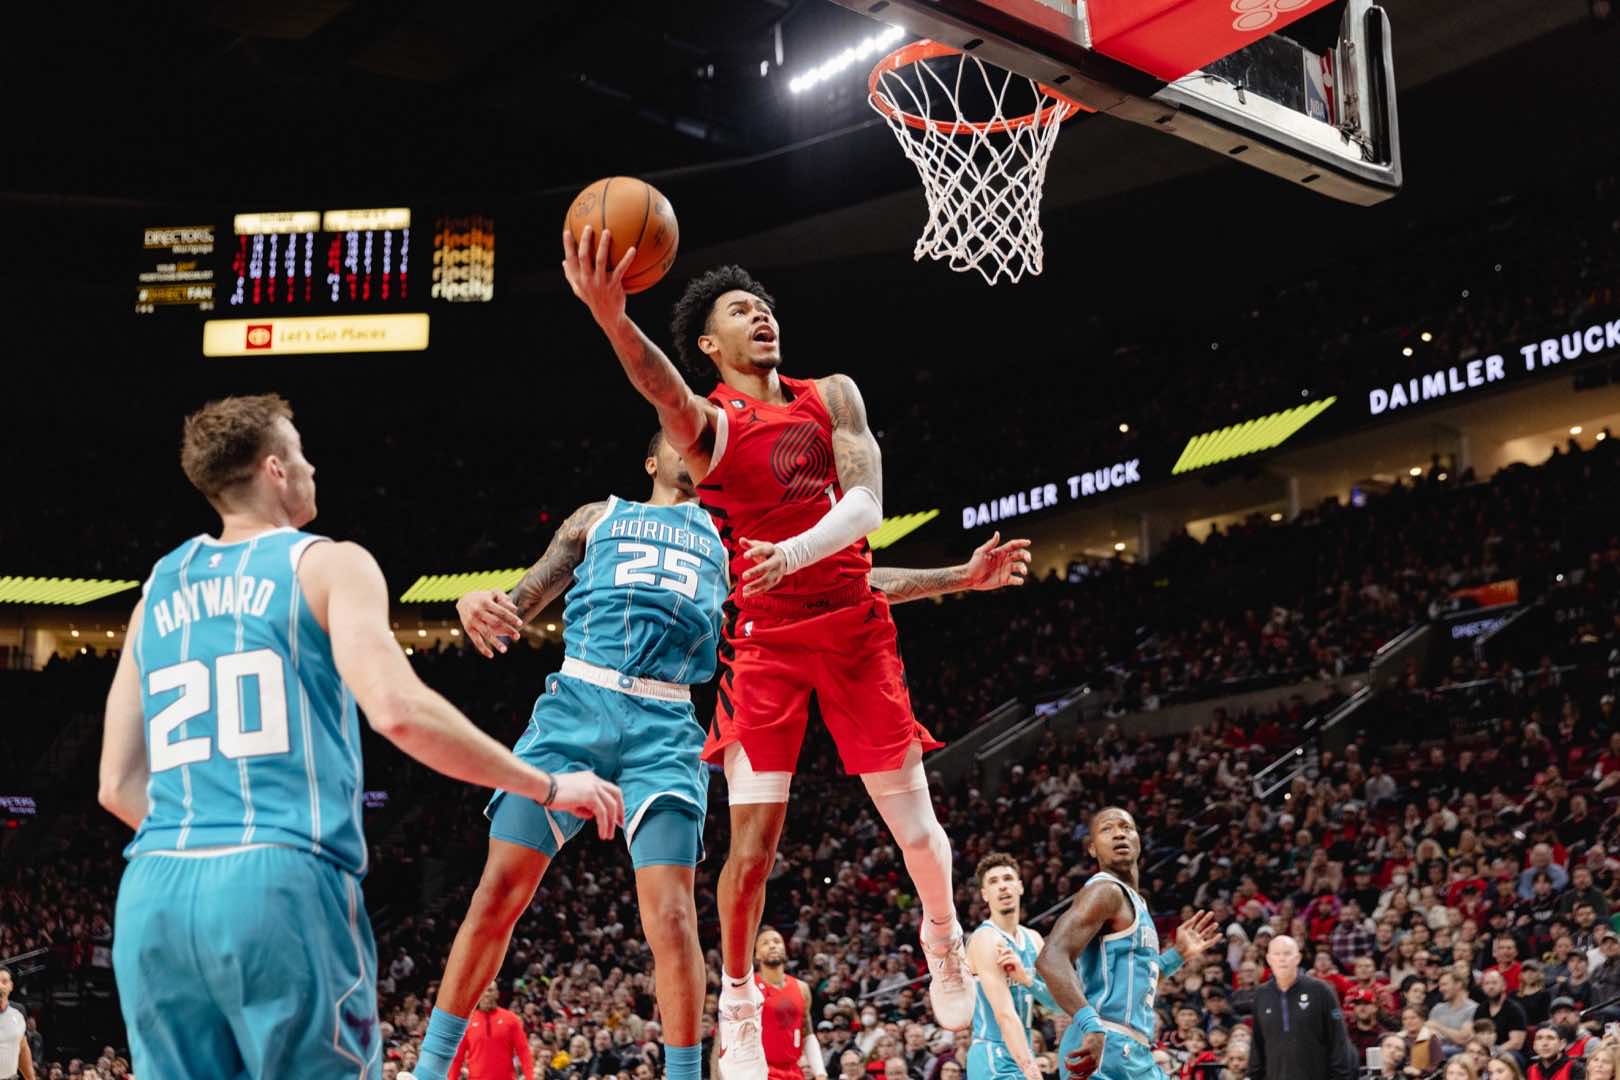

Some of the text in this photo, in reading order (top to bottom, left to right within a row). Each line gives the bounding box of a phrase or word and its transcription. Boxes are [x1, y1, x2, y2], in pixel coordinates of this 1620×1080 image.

[315, 328, 336, 341] Go
[1368, 354, 1505, 415] DAIMLER
[962, 458, 1141, 530] DAIMLER TRUCK
[611, 519, 712, 558] HORNETS
[614, 542, 703, 601] 25
[153, 575, 276, 638] HAYWARD
[148, 648, 290, 774] 20
